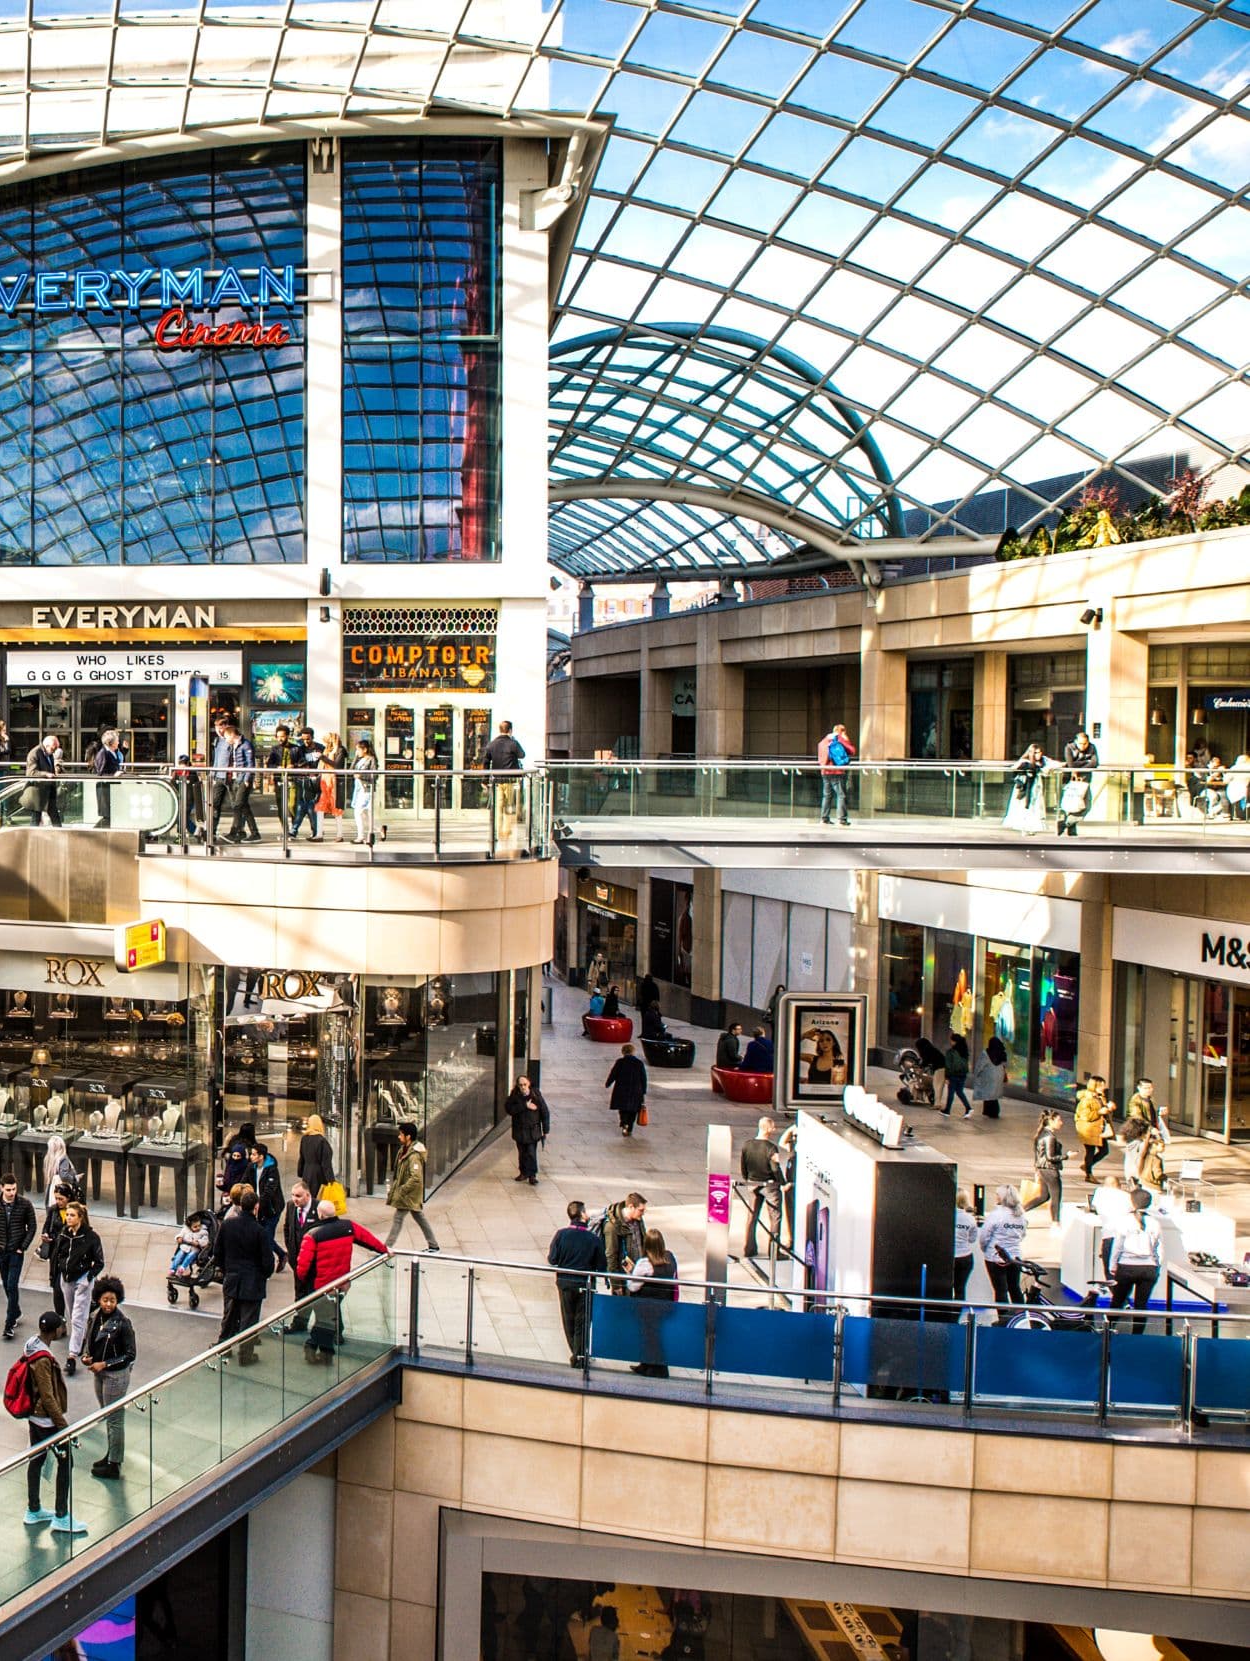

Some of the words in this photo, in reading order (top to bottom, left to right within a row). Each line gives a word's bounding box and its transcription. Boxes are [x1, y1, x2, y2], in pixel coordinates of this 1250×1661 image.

[155, 308, 291, 349] Cinema
[32, 605, 215, 629] EVERYMAN
[76, 655, 107, 667] WHO
[126, 655, 165, 666] LIKES
[350, 644, 490, 665] COMPTOIR
[27, 670, 37, 682] G
[41, 670, 52, 682] G
[56, 670, 67, 682] G
[73, 670, 83, 682] G
[89, 670, 133, 681] GHOST
[144, 670, 201, 681] STOR
[219, 671, 229, 680] 15
[382, 667, 457, 679] LIBANAIS
[1201, 932, 1250, 970] M&
[44, 957, 106, 988] ROX
[260, 970, 325, 1000] ROX
[31, 1078, 49, 1088] ROX
[88, 1083, 106, 1094] ROX
[149, 1089, 166, 1099] ROX
